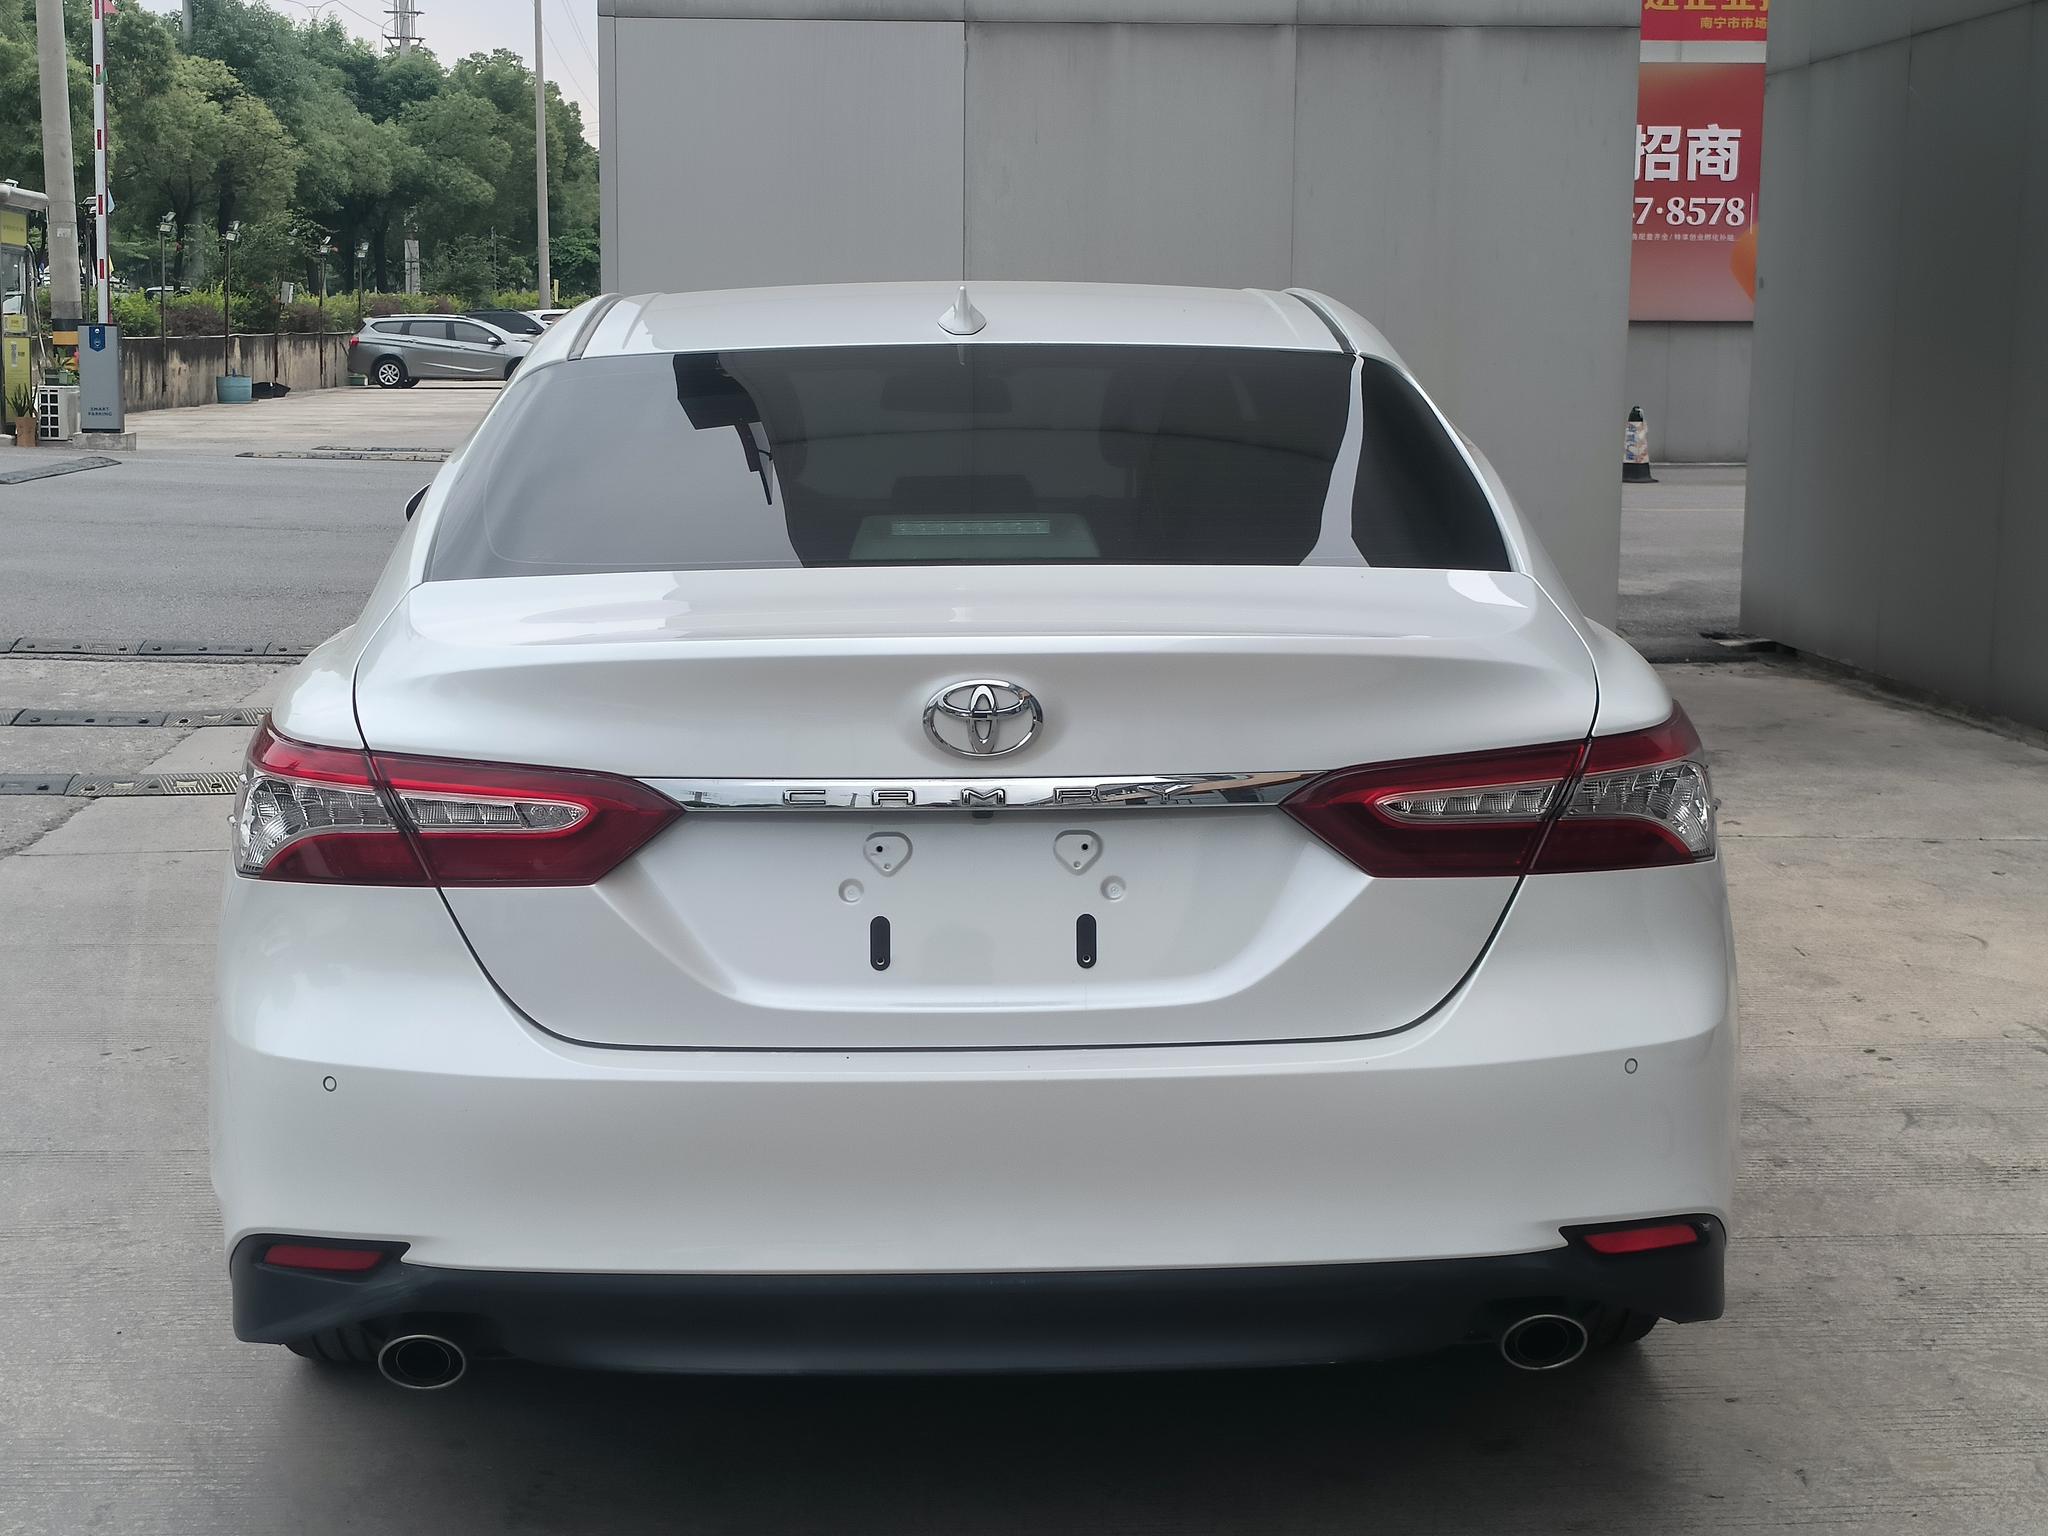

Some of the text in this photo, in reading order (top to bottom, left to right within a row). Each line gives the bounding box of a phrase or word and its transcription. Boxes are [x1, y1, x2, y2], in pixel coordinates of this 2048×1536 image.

[1700, 17, 1767, 29] 南宁市市场
[1634, 123, 1742, 181] 招商
[1633, 196, 1745, 226] 7·8578
[783, 784, 1193, 806] CAMRY
